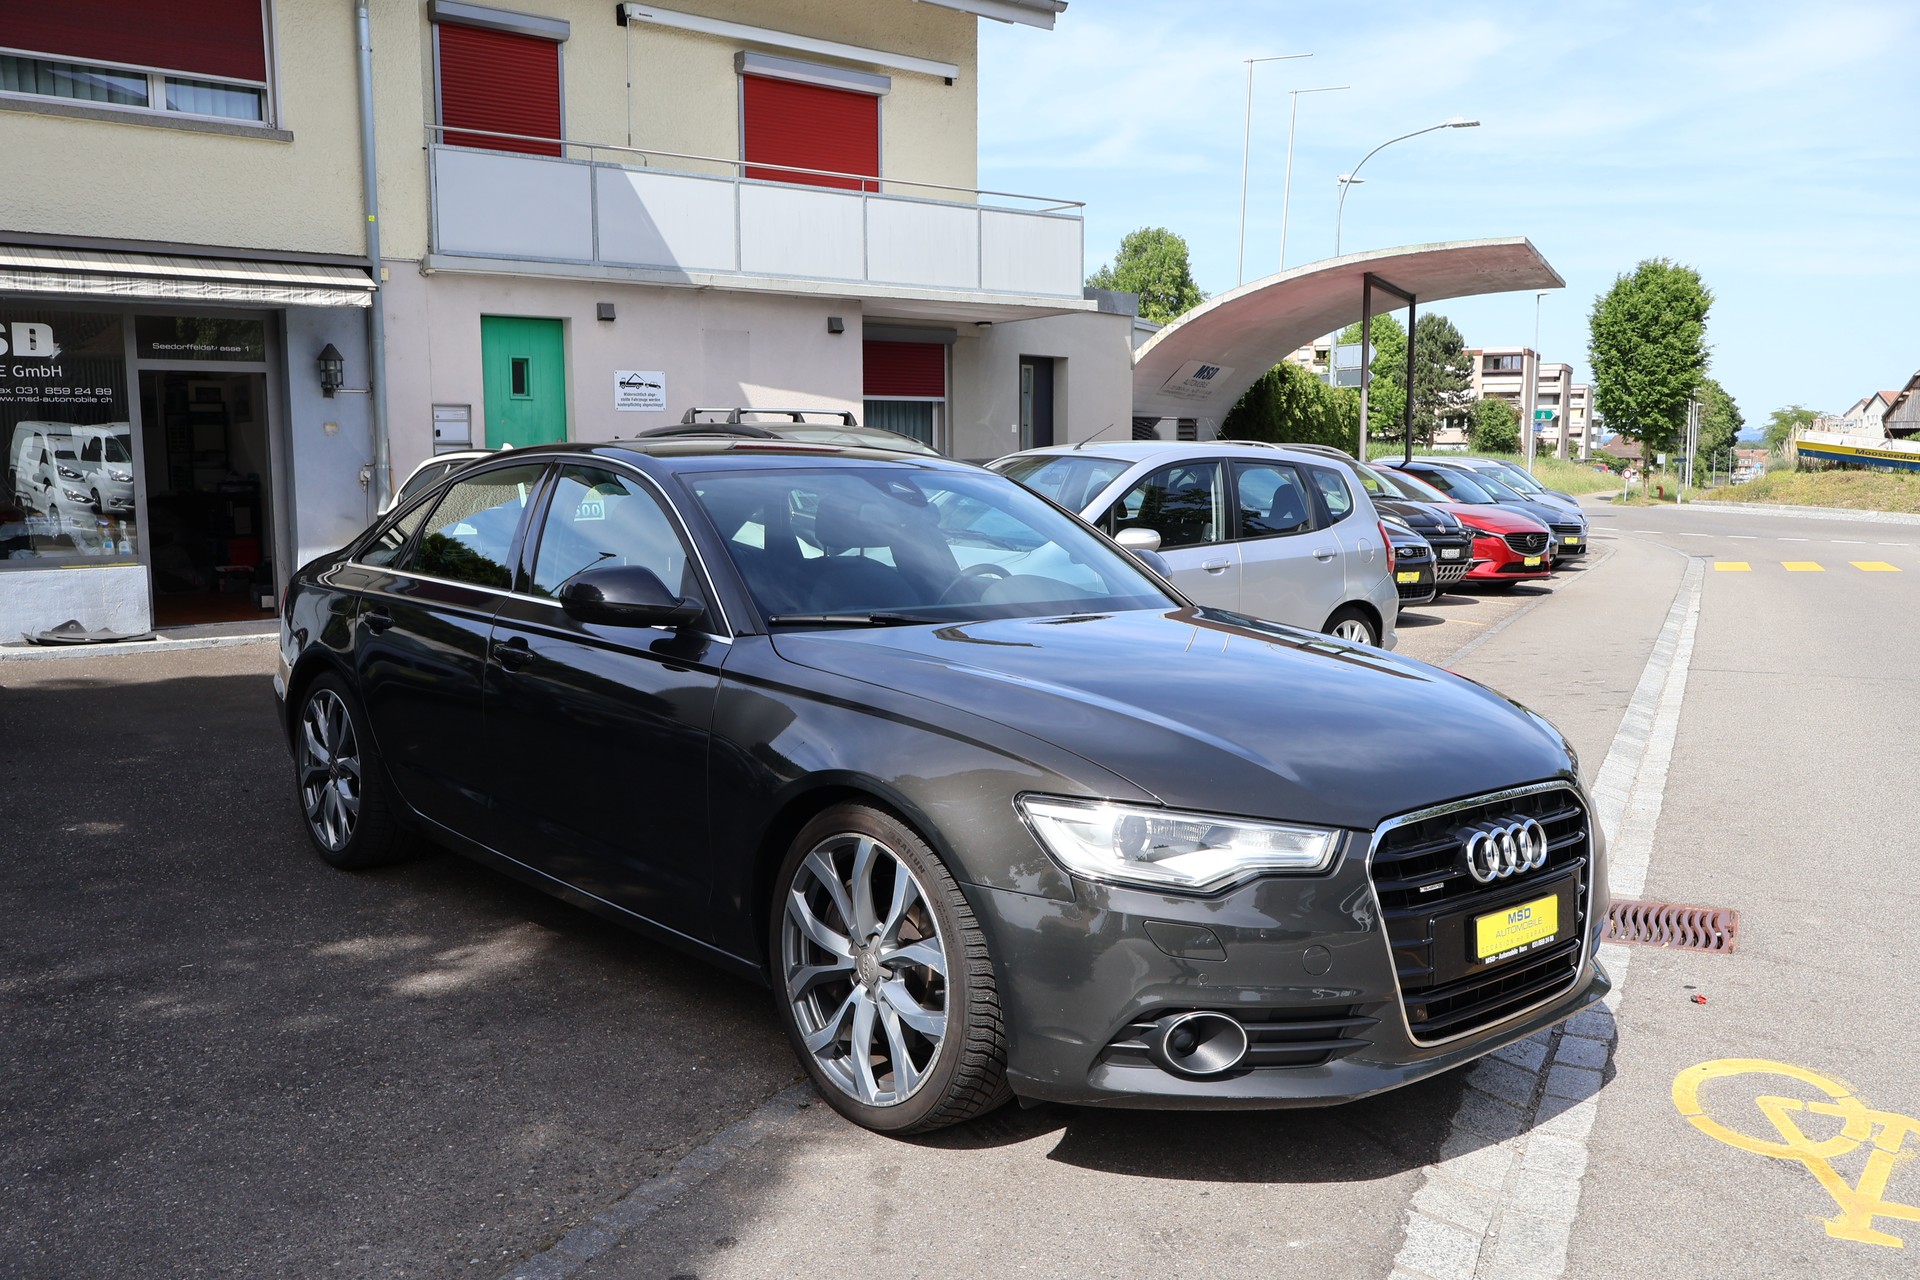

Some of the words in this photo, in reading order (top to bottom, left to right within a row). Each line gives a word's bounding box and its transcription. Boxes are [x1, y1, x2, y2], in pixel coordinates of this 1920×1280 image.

[0, 322, 54, 357] D
[12, 365, 62, 377] GmbH
[1193, 364, 1220, 380] MSD
[15, 386, 39, 394] 031
[45, 387, 70, 395] 859
[75, 387, 91, 395] 24
[95, 387, 112, 395] 89
[896, 837, 925, 874] SAILUN
[1507, 907, 1531, 925] MSD
[1495, 917, 1543, 938] AUTOMOBILE
